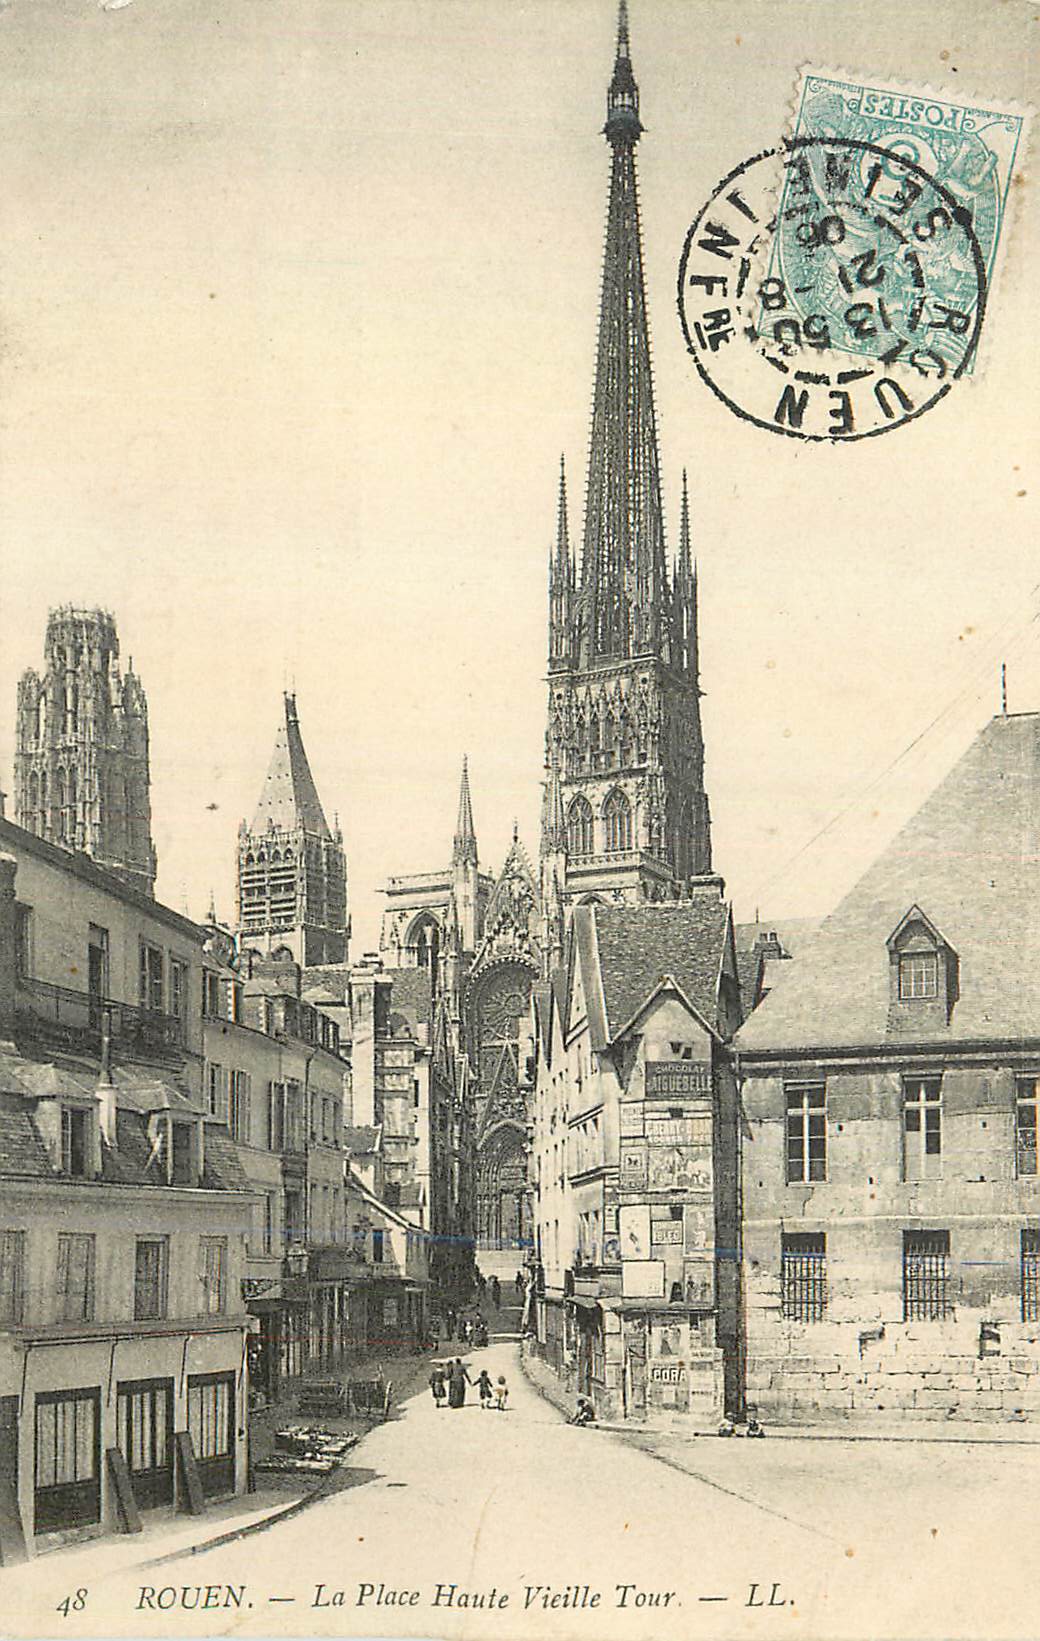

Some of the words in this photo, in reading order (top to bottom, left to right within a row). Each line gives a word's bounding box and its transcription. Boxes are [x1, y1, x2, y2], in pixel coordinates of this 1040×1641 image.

[863, 93, 960, 131] POSTES
[774, 304, 971, 435] ROUEN
[656, 1064, 705, 1074] CHOCOLAT
[652, 1367, 687, 1382] CORA
